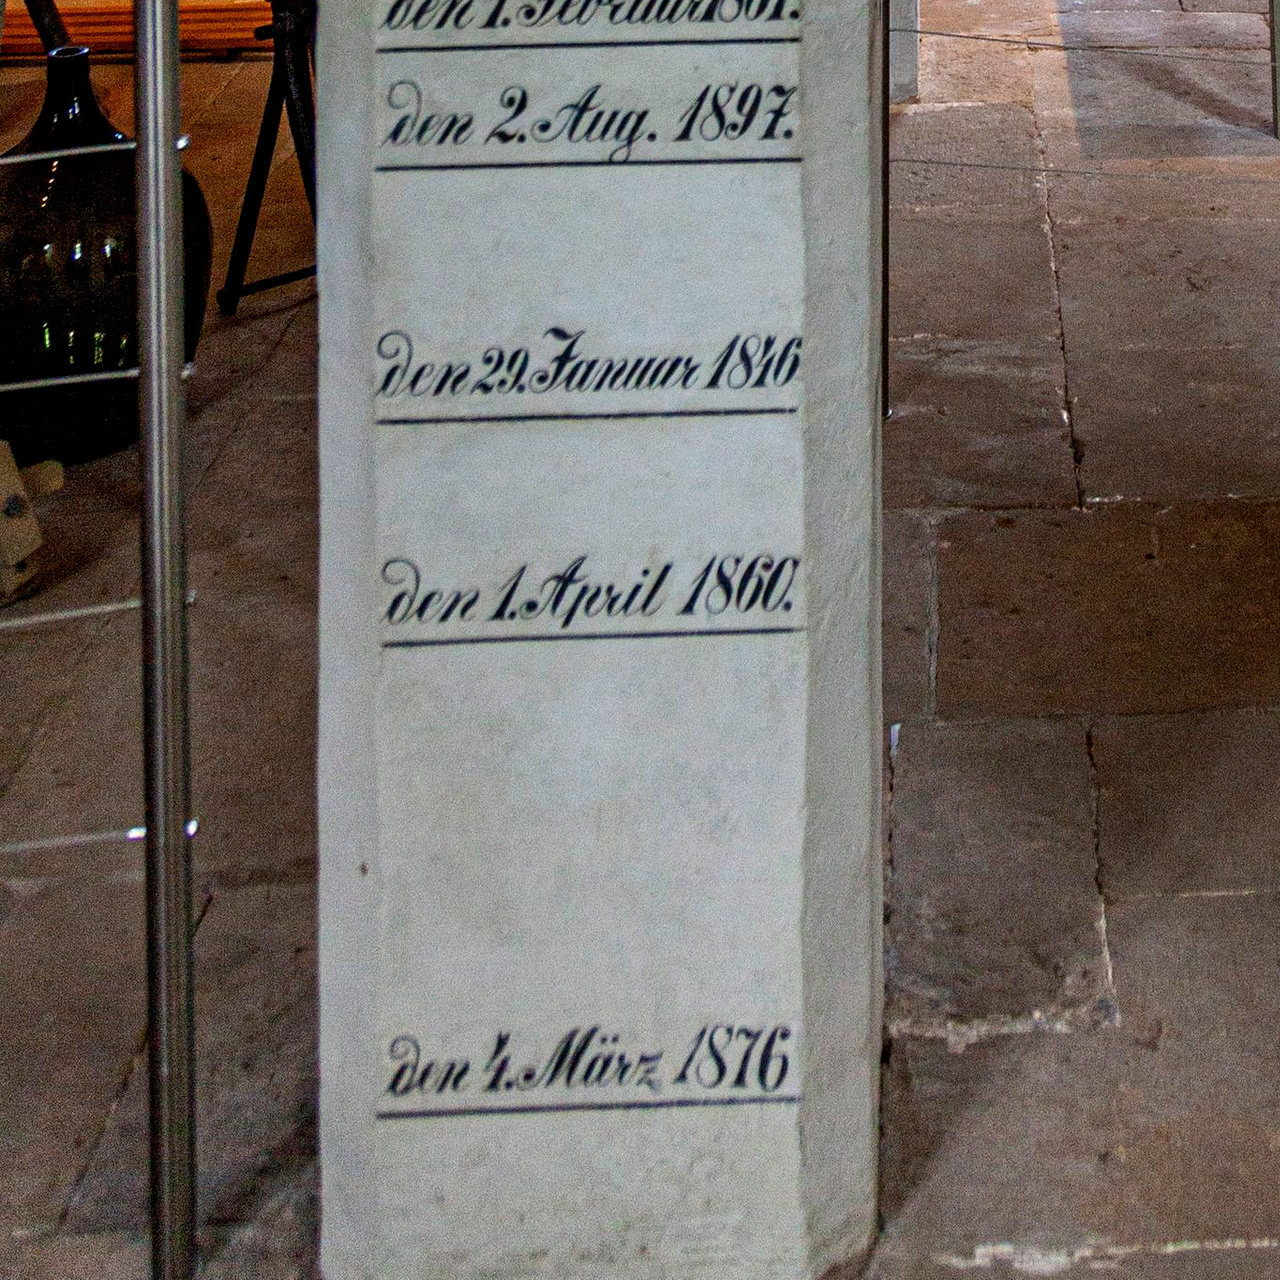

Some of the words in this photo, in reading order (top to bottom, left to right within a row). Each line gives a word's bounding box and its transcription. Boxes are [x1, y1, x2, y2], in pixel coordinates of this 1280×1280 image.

[382, 80, 474, 146] den
[484, 88, 528, 146] 2.
[534, 83, 658, 165] Aug.
[673, 82, 797, 142] 1897.
[374, 330, 471, 397] den
[470, 347, 532, 396] 29.
[527, 326, 700, 394] Januar
[704, 333, 804, 390] 1846
[380, 558, 480, 624] den
[488, 564, 519, 622] 1.
[518, 555, 674, 630] April
[680, 555, 796, 616] 1860.
[386, 1032, 470, 1099] den
[482, 1030, 519, 1094] 4.
[519, 1027, 662, 1092] März
[673, 1026, 792, 1092] 1876
